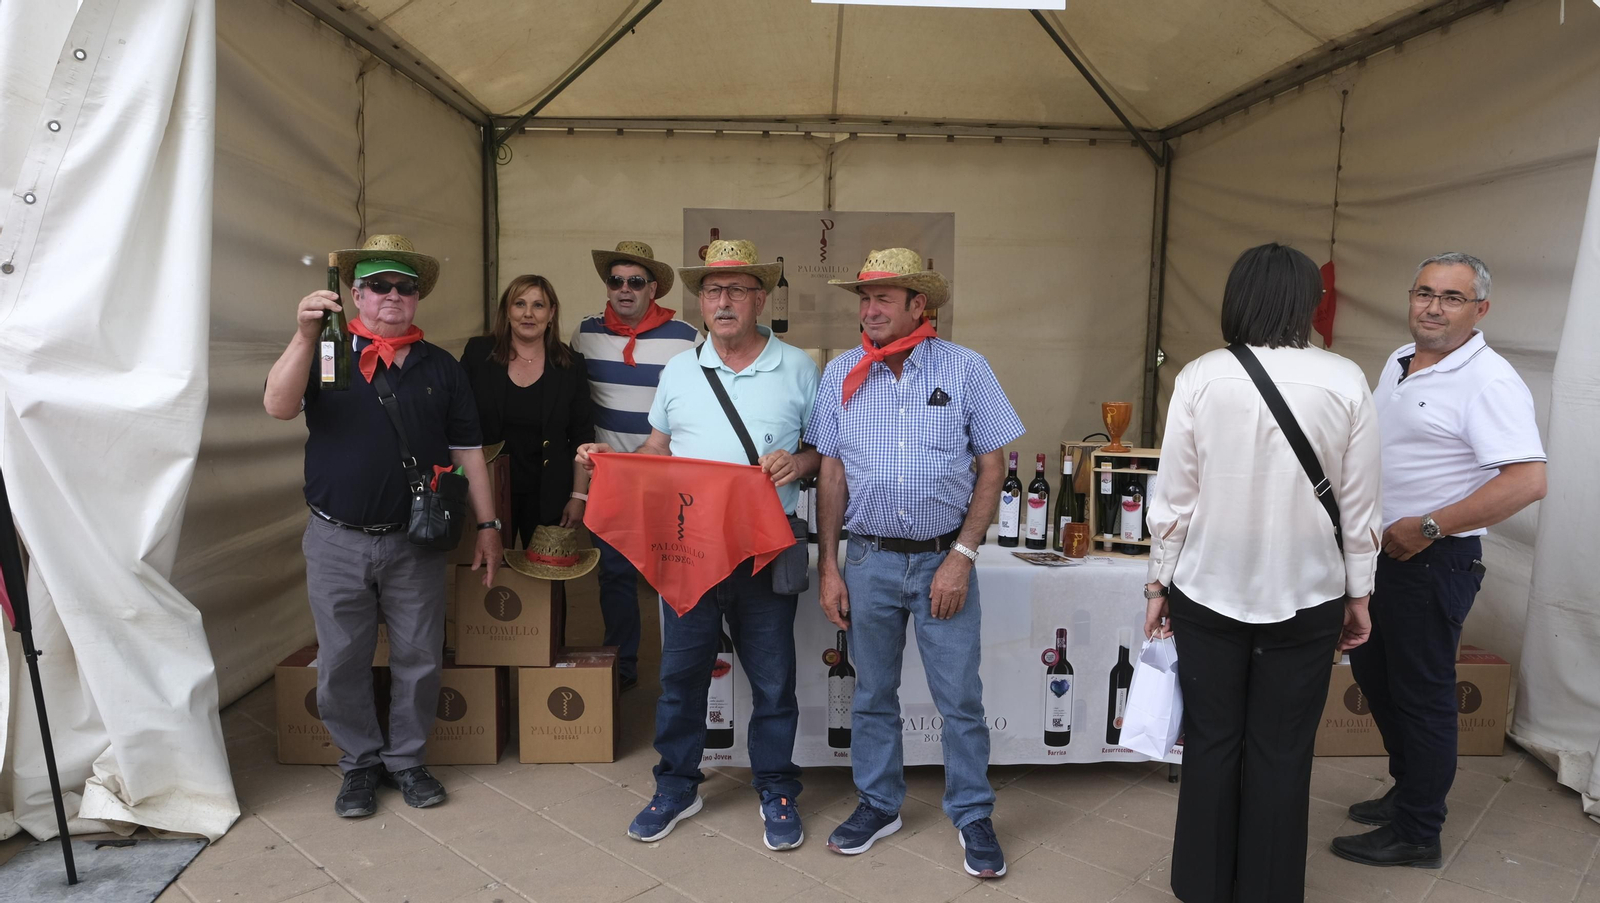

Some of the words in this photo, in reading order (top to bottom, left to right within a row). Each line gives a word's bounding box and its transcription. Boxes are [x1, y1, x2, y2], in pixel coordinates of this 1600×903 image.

[797, 265, 849, 273] PALOMILLO
[651, 543, 705, 559] PALOMILLO
[465, 624, 539, 636] PALOMILLO
[530, 725, 602, 735] PALOMILLO
[714, 752, 732, 761] Joven
